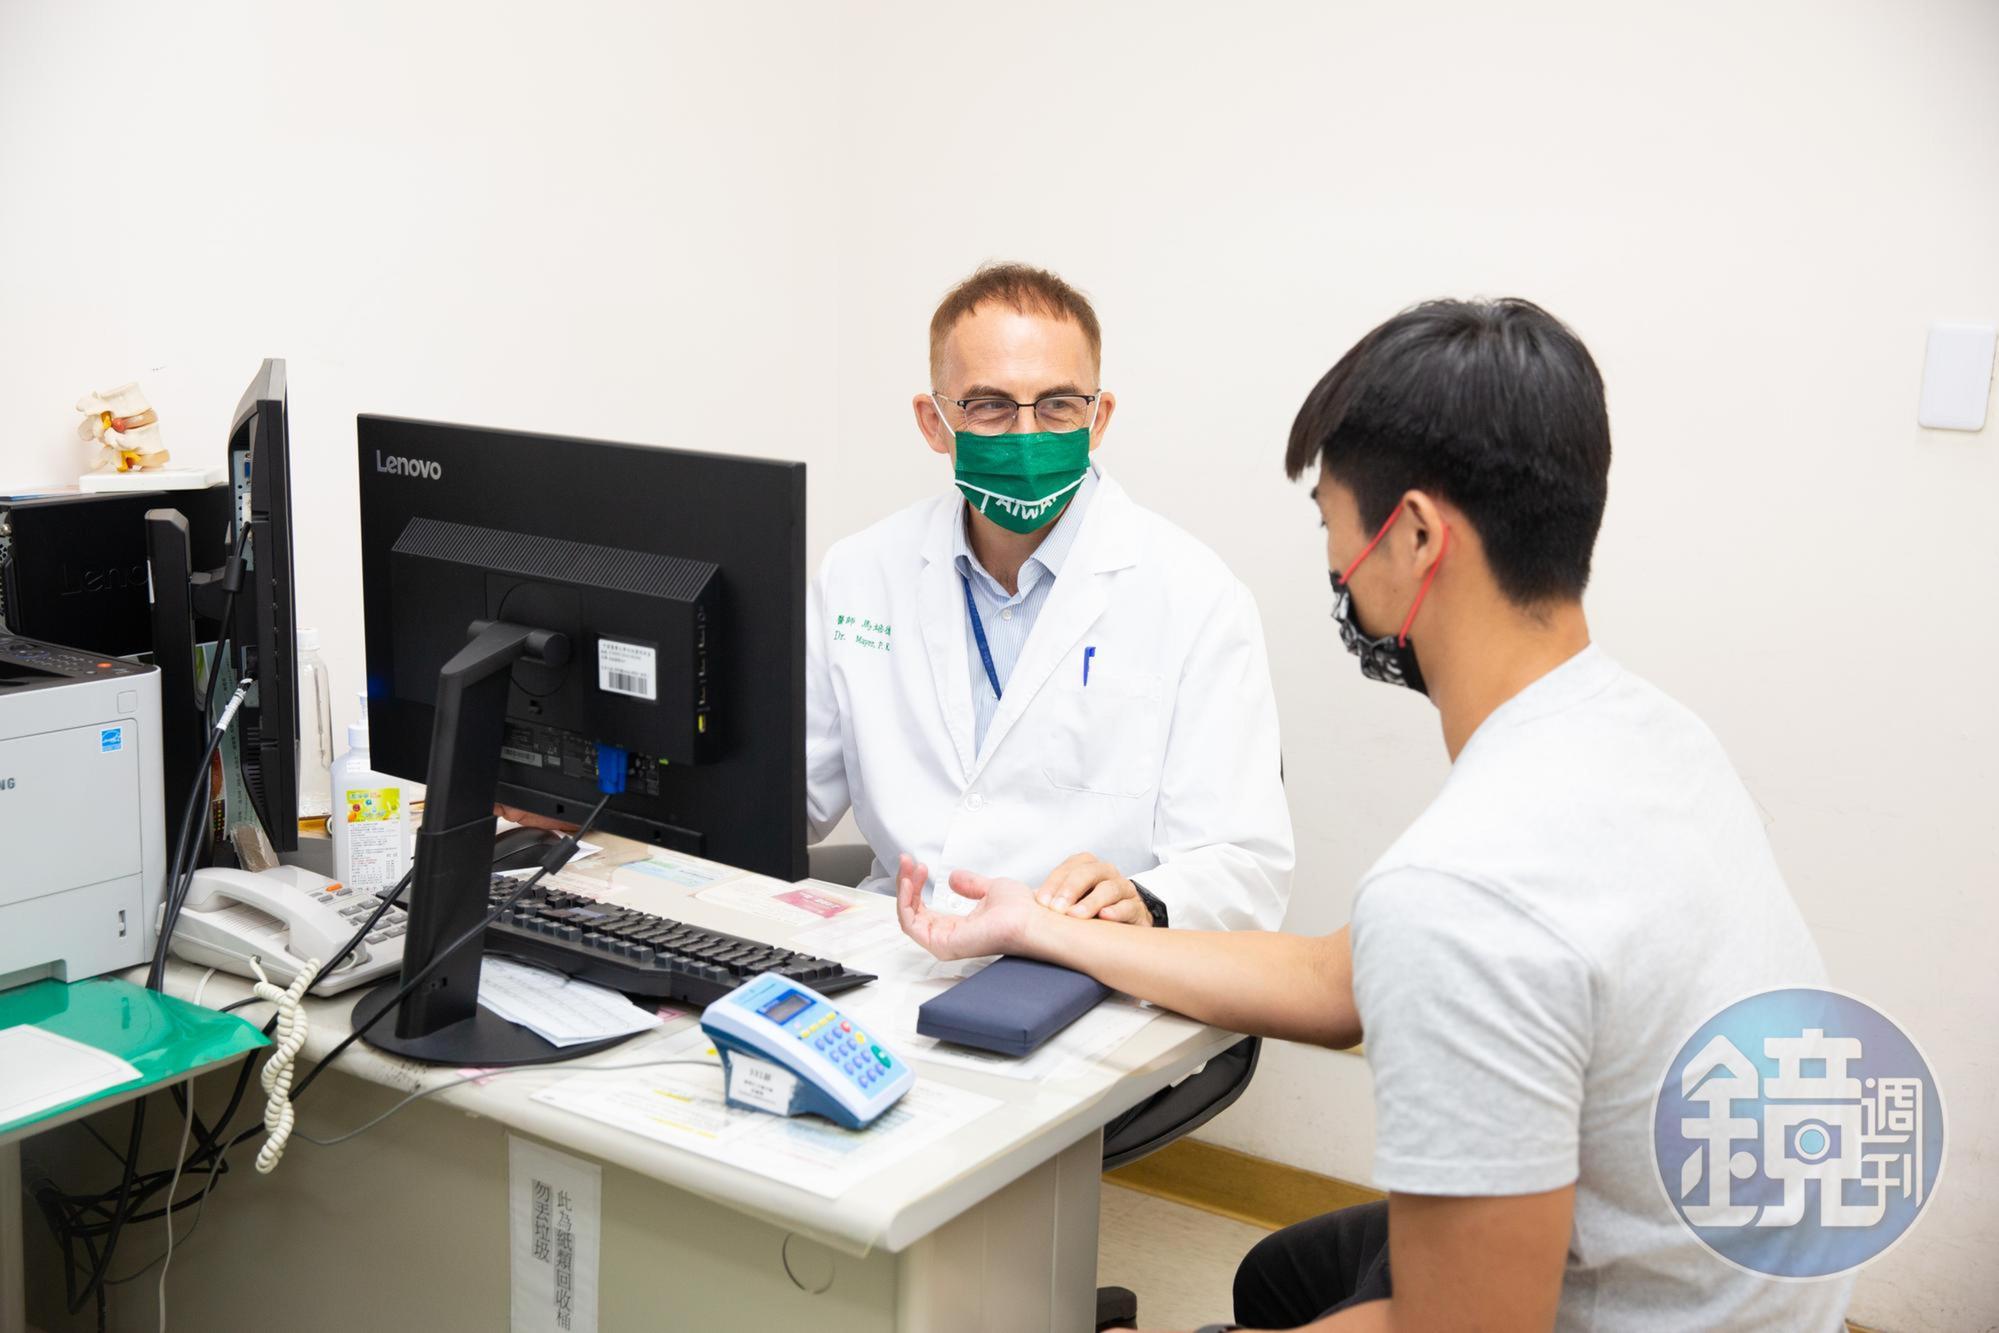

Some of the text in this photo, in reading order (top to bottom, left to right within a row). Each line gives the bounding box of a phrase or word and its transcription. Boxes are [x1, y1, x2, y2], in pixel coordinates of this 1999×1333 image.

[376, 449, 442, 480] Lenovo
[61, 562, 149, 599] Leno
[833, 629, 846, 641] Dr.
[533, 1180, 551, 1264] 勿丟垃圾
